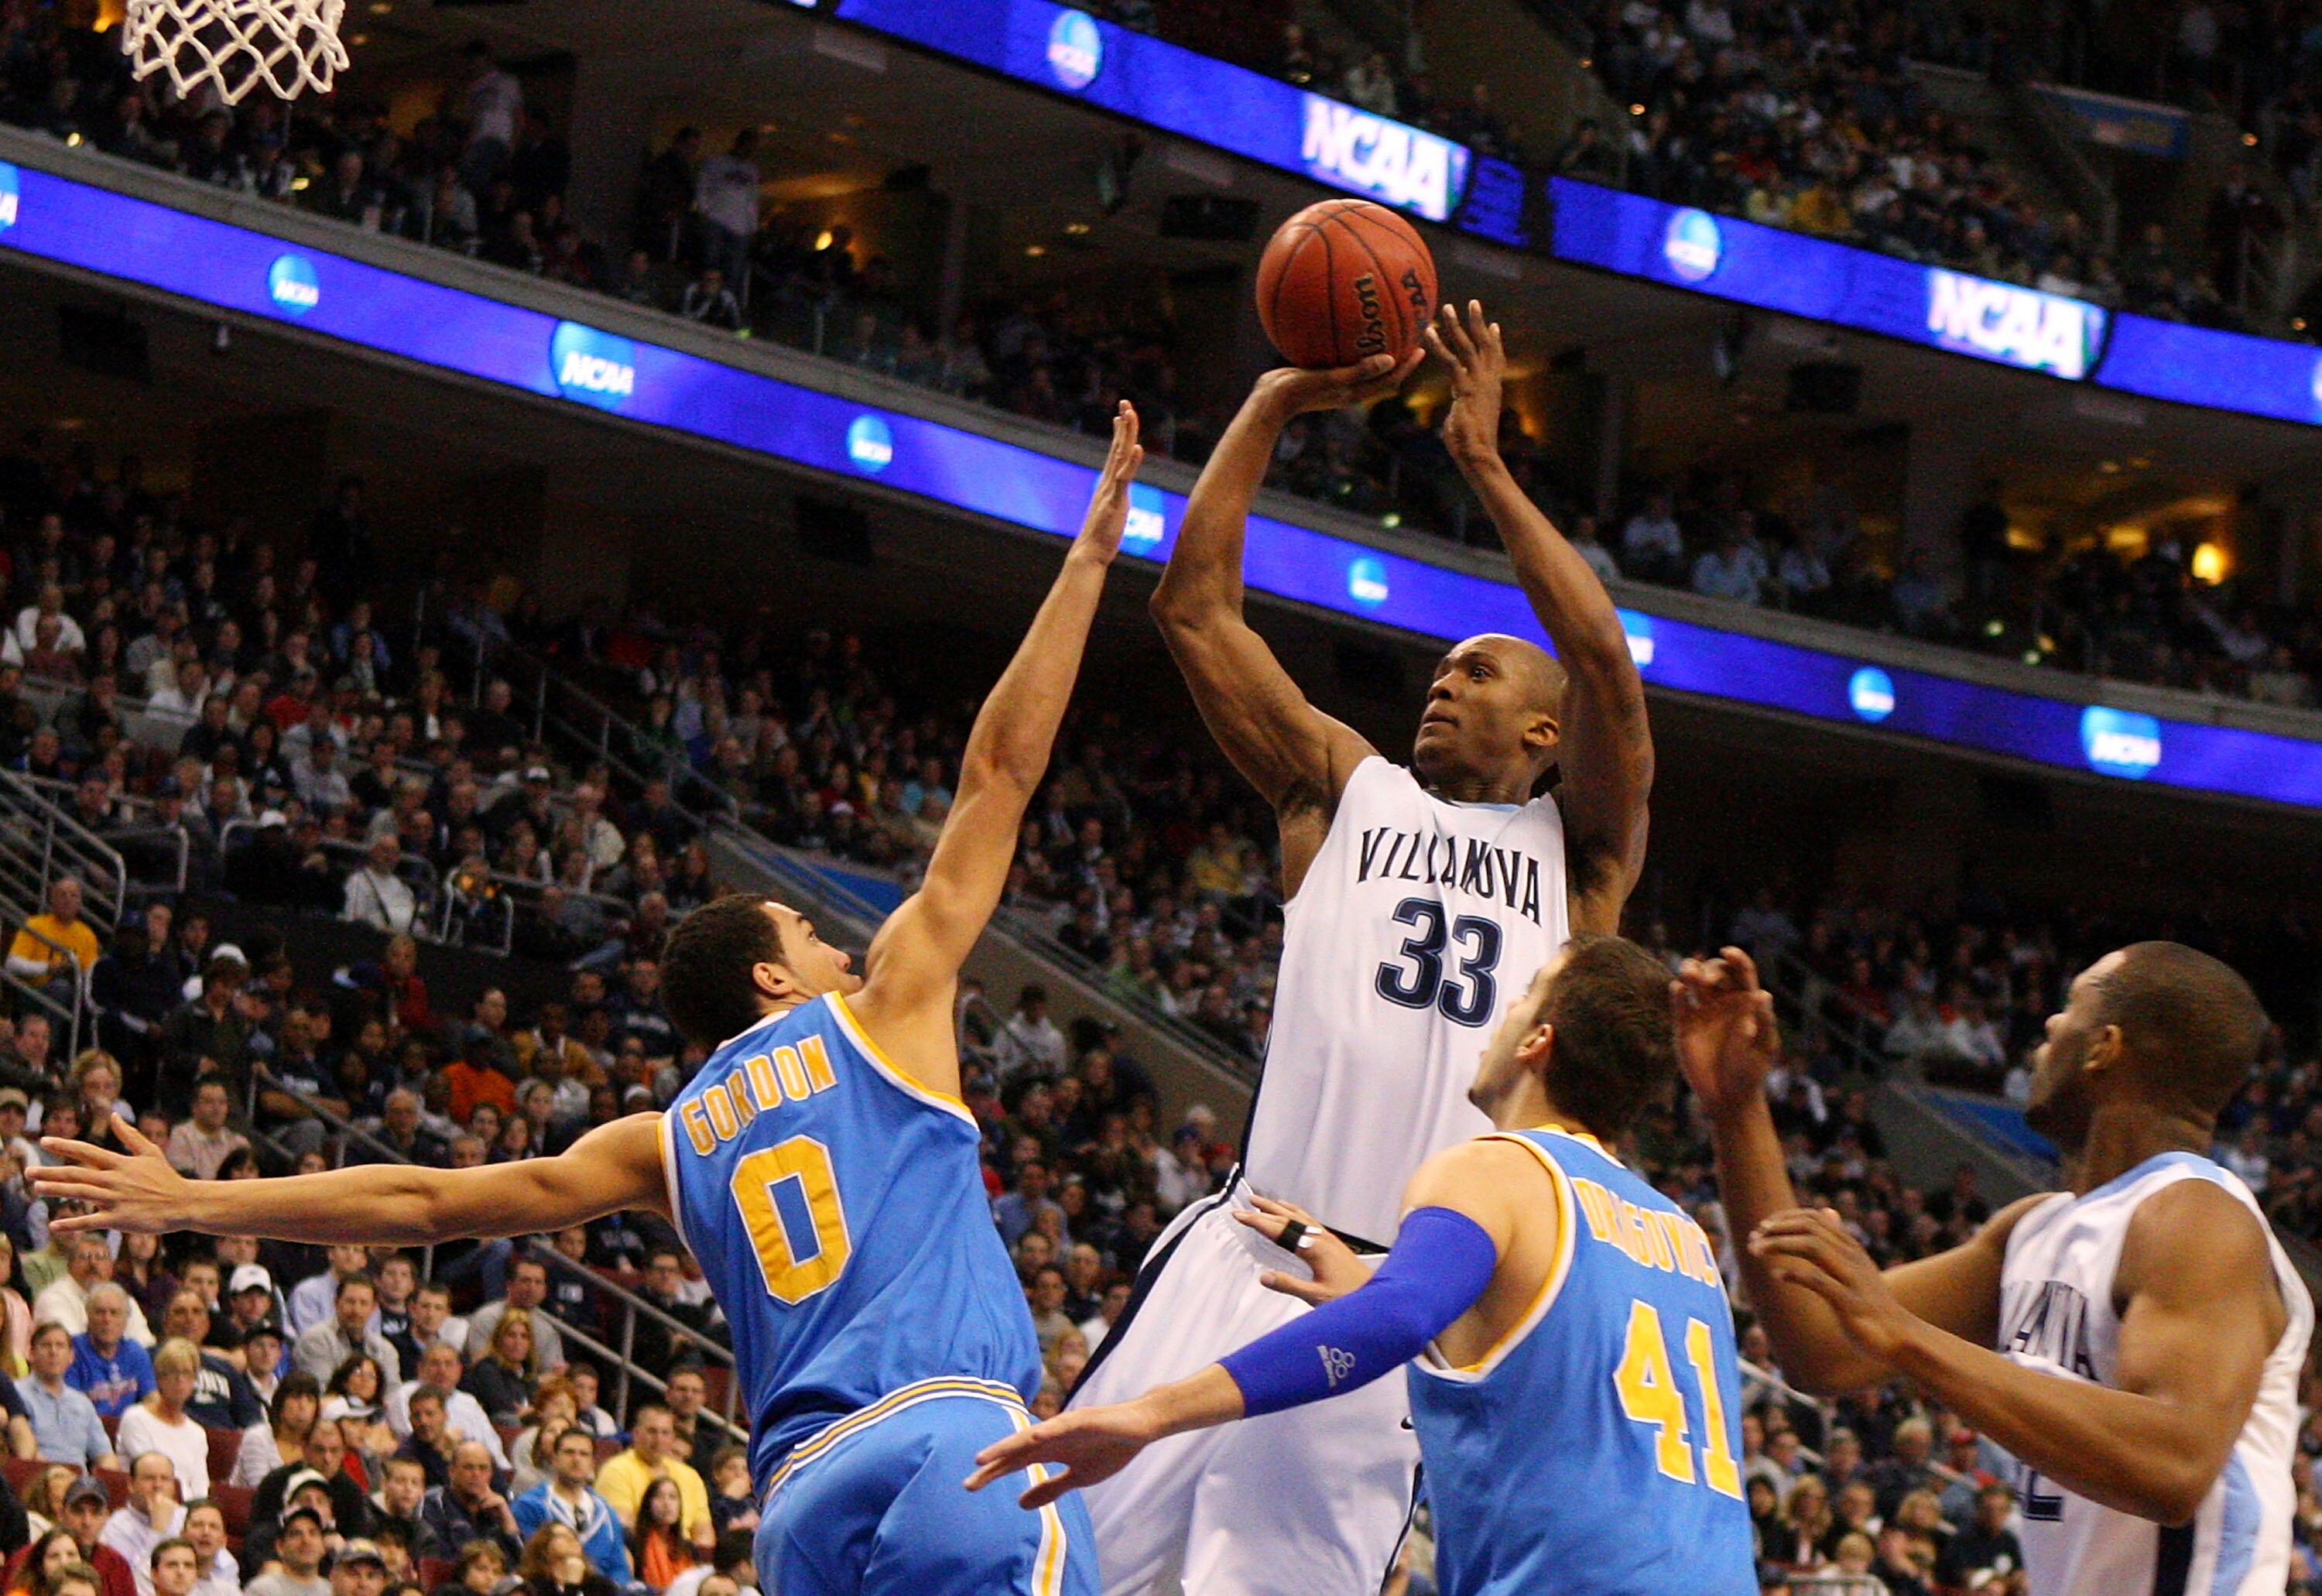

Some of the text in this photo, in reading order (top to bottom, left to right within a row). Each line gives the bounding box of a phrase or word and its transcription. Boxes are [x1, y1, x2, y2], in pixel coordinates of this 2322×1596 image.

[1302, 99, 1447, 221] NCAA
[560, 351, 633, 394] NCAA
[1928, 272, 2084, 379] NCAA
[1356, 827, 1543, 929] VILLANOVA
[1375, 897, 1503, 1028] 33
[680, 1034, 838, 1156] GORDON
[730, 1134, 852, 1307] 0
[1612, 1298, 1745, 1502] 41
